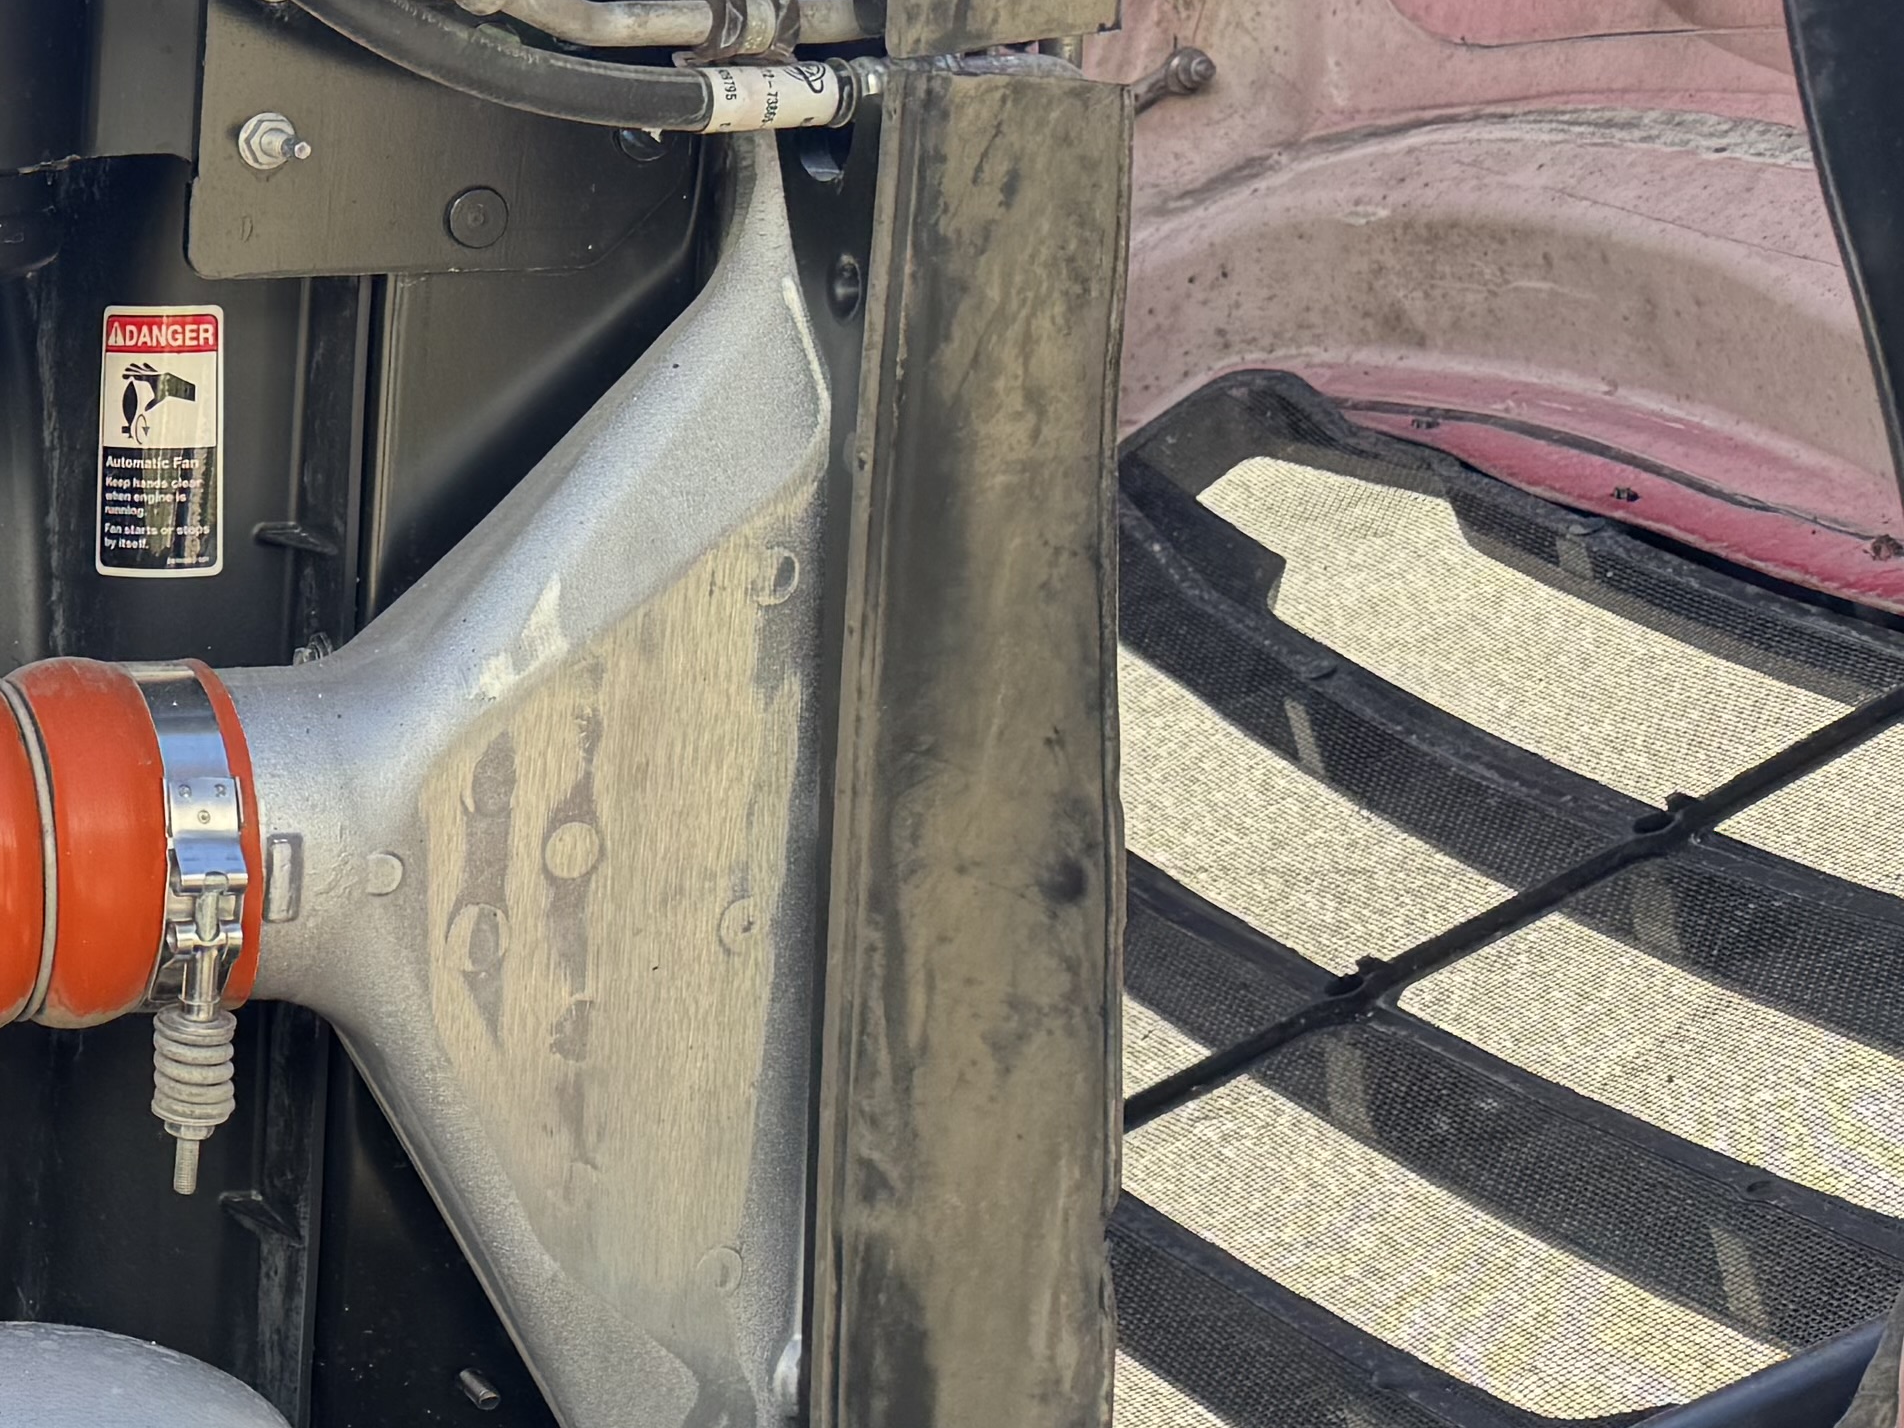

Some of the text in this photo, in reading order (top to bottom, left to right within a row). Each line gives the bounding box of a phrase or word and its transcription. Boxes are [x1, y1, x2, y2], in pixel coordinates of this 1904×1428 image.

[125, 323, 215, 347] DANGER
[106, 456, 199, 469] Automatic Fan
[105, 477, 131, 489] Keep
[133, 477, 168, 488] hands
[105, 491, 131, 502] when
[133, 490, 174, 504] engine
[104, 523, 210, 536] Fan starts or stops
[104, 538, 117, 549] by
